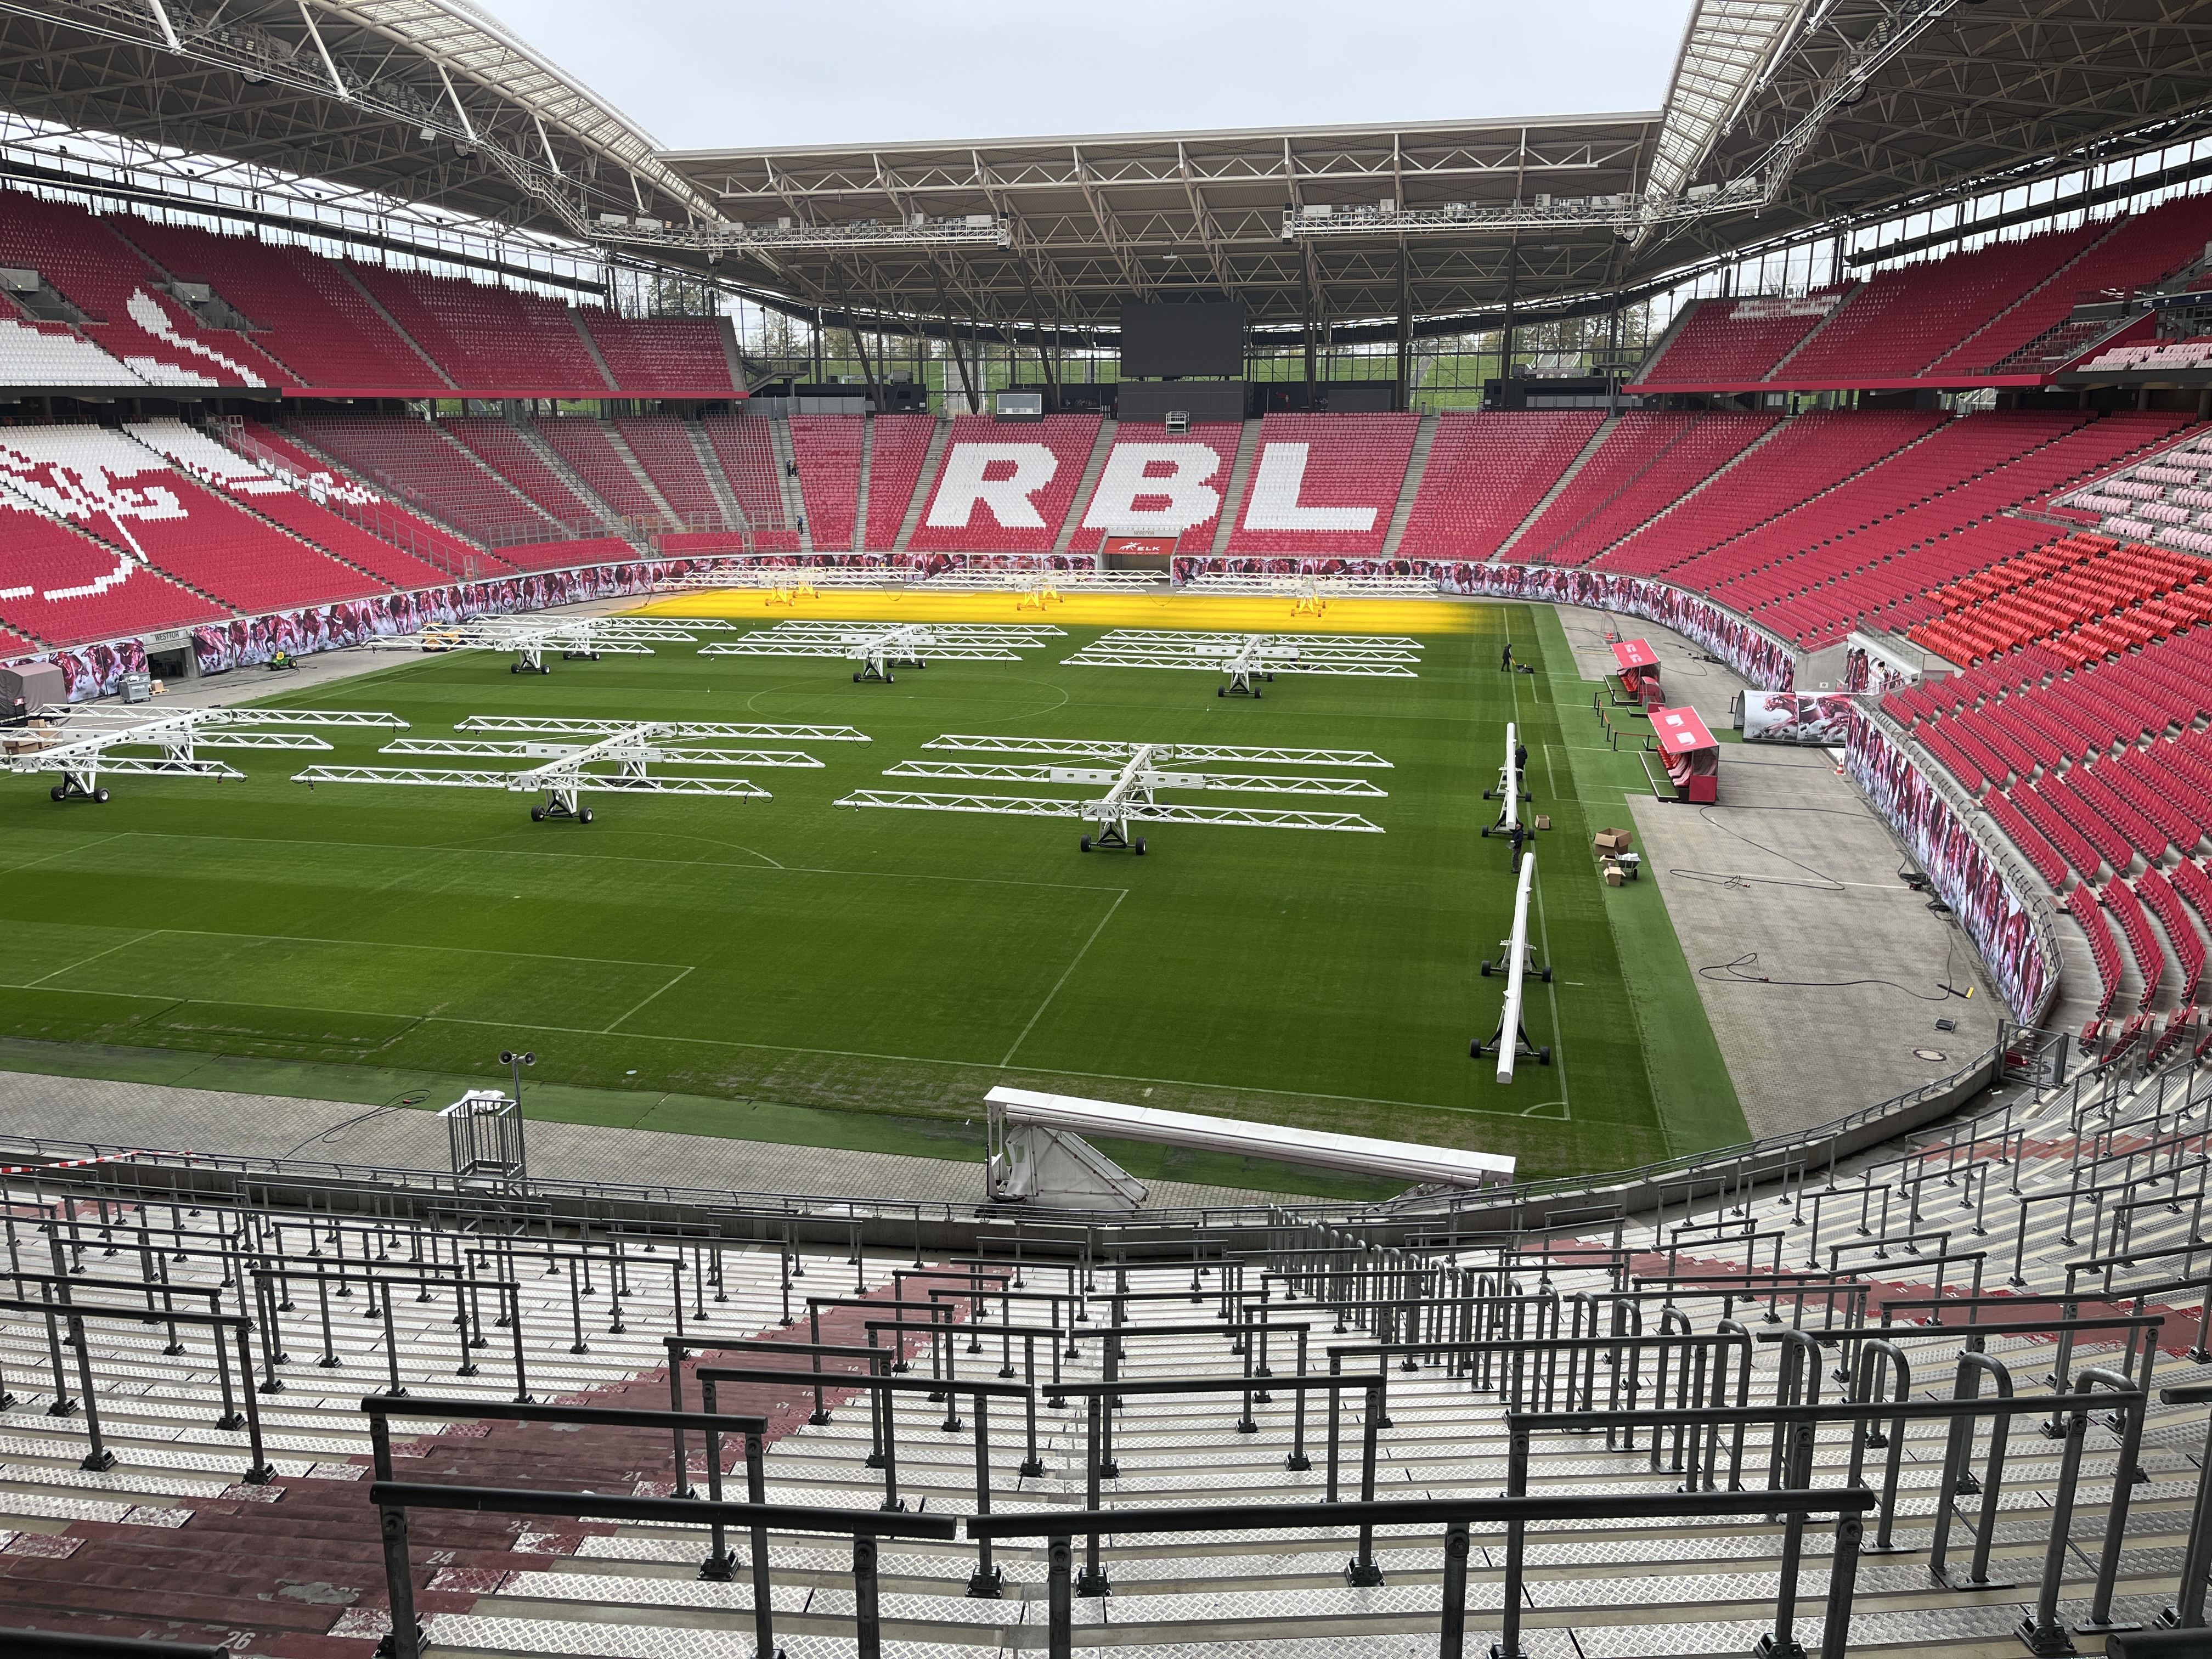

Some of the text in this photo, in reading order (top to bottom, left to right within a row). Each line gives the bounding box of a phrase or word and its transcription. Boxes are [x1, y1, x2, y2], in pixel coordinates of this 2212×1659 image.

[927, 443, 1378, 531] RBL
[154, 630, 179, 641] WESTTOR
[621, 1471, 642, 1481] 21
[505, 1520, 532, 1533] 23
[426, 1550, 456, 1565] 24
[218, 1631, 256, 1650] 26
